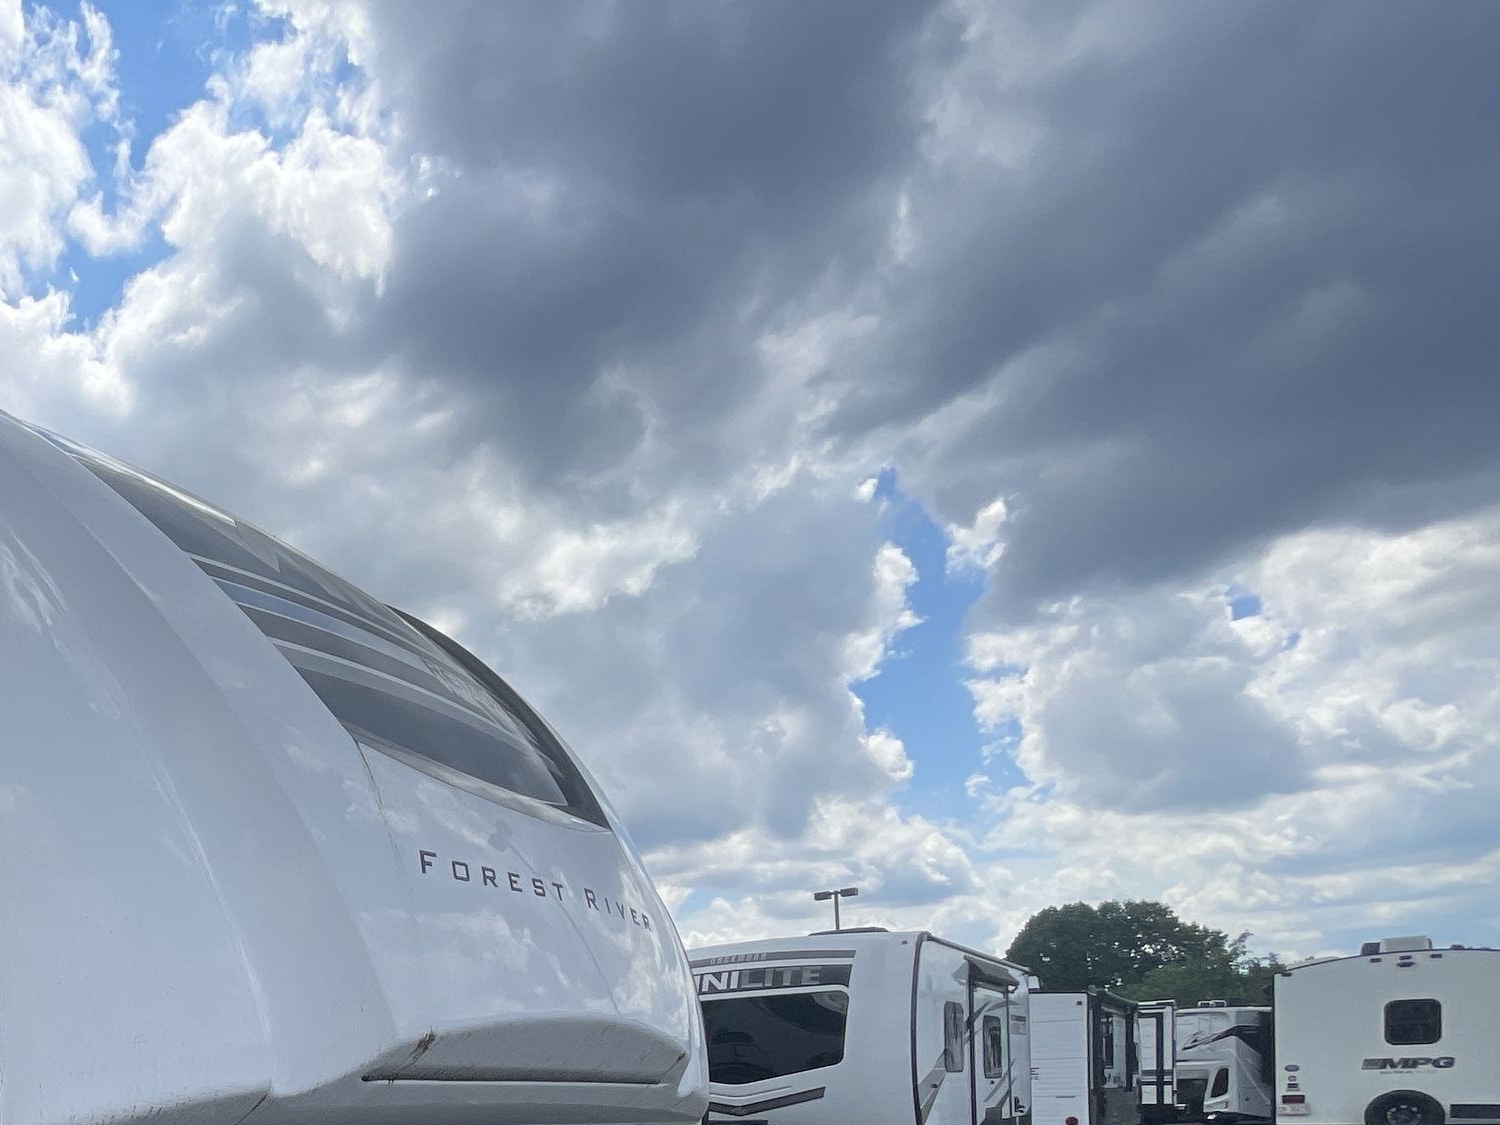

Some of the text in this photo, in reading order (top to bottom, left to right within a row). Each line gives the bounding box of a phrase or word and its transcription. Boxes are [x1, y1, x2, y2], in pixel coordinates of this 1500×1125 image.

[419, 849, 651, 931] FOREST RIVER
[1376, 1056, 1455, 1069] MPG
